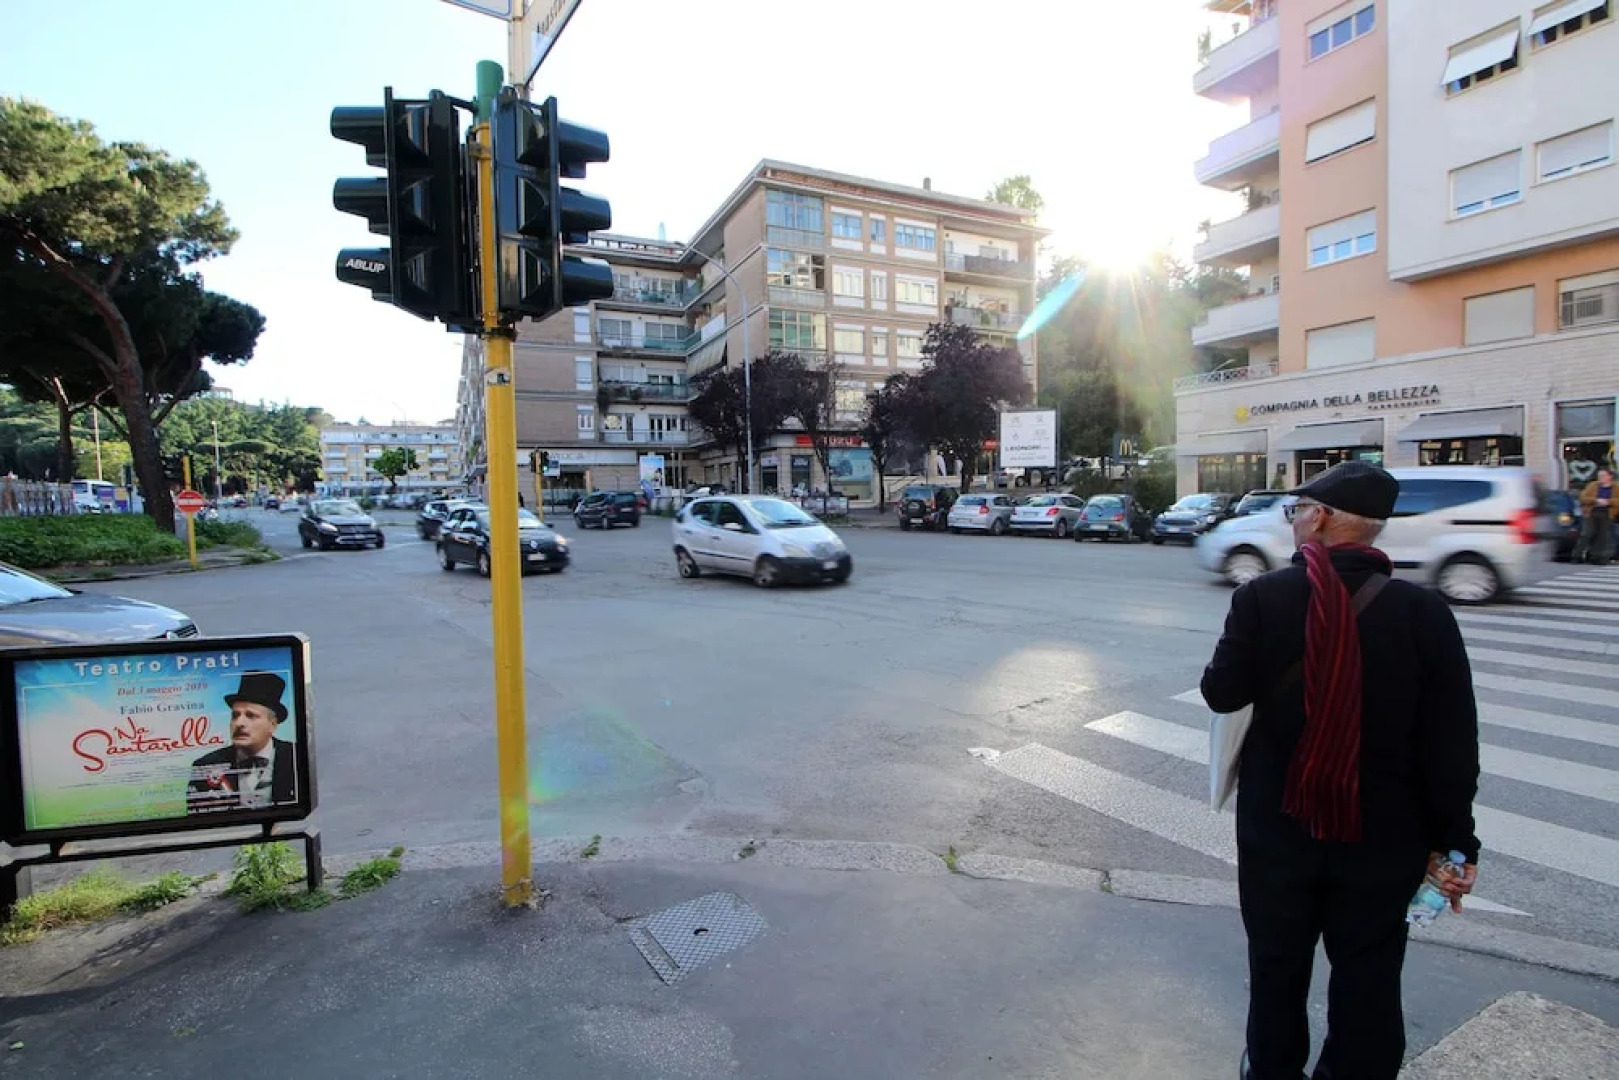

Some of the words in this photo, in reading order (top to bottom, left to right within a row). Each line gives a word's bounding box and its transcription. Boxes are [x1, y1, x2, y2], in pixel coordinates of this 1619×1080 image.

[345, 258, 386, 273] ABLUP
[1250, 399, 1319, 416] COMPAGNIA
[1323, 393, 1362, 408] DELLA
[1367, 384, 1440, 402] BELLEZZA
[74, 659, 162, 678] Teatro
[176, 652, 239, 670] Prati
[120, 704, 153, 715] Fabio
[156, 700, 205, 713] Gravina
[72, 716, 224, 773] Santarella
